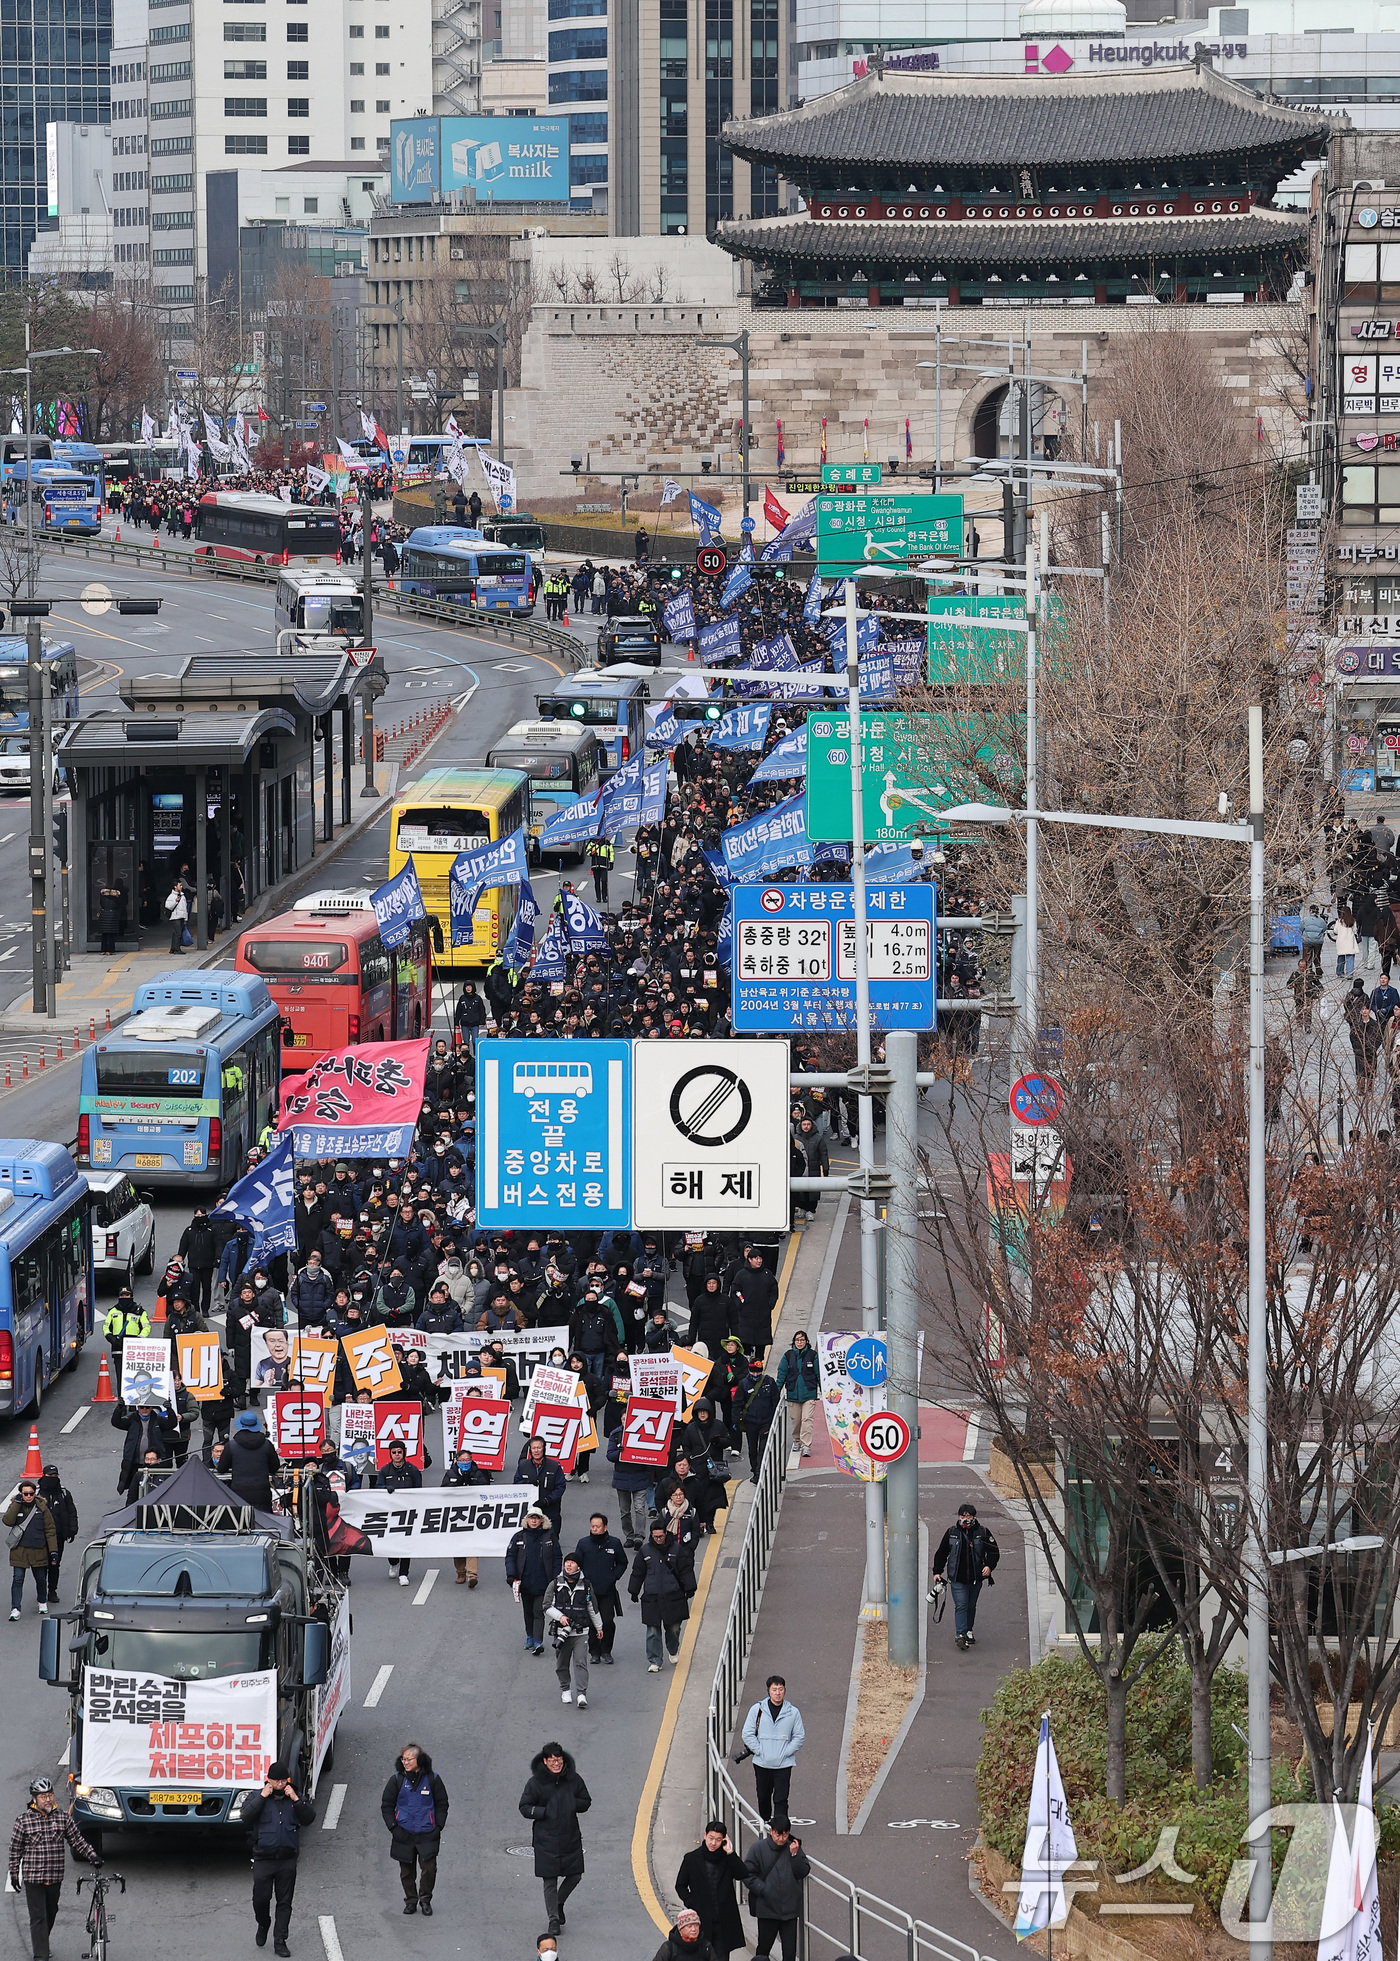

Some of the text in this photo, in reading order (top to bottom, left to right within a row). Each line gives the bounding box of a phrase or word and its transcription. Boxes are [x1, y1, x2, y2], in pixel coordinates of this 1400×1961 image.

[1090, 42, 1189, 66] Heungkuk
[508, 143, 560, 158] 복사지는
[509, 160, 553, 178] miilk
[1357, 321, 1391, 339] 사교
[1345, 399, 1373, 411] 지루박
[829, 468, 873, 480] 숭례문
[834, 500, 867, 512] 광화문
[907, 530, 949, 542] 한국은행
[907, 543, 960, 551] The Bank Of Korea
[703, 556, 719, 568] 50
[599, 707, 614, 718] 151
[815, 724, 830, 735] 50
[831, 752, 845, 763] 60
[869, 763, 885, 773] Hall
[875, 827, 908, 839] 180m
[453, 837, 488, 850] 4108
[869, 890, 907, 911] 제한
[743, 926, 791, 947] 총중량
[798, 929, 827, 946] 32t
[891, 924, 926, 938] 4.0m
[884, 943, 926, 956] 16.7m
[303, 955, 330, 968] 9401
[743, 955, 827, 975] 축하중 10t
[892, 961, 926, 975] 2.5m
[740, 1000, 779, 1011] 2004년
[783, 1000, 800, 1011] 3월
[172, 1069, 197, 1084] 202
[130, 1101, 161, 1110] Beauty
[527, 1098, 579, 1124] 전용
[541, 1124, 566, 1148] 끝
[503, 1149, 604, 1176] 중앙차로
[669, 1170, 752, 1200] 해제
[503, 1181, 604, 1208] 버스전용
[125, 1351, 166, 1362] 윤석열을
[352, 1336, 393, 1387] 주
[125, 1362, 166, 1372] 체포하라
[182, 1345, 220, 1388] 내
[536, 1367, 574, 1385] 금속노조
[639, 1375, 678, 1387] 윤석열을
[533, 1378, 572, 1396] 선봉에서
[639, 1386, 678, 1397] 체포하라
[280, 1402, 323, 1445] 윤
[345, 1419, 375, 1430] 윤석열
[625, 1408, 674, 1451] 진
[376, 1413, 421, 1457] 석
[460, 1408, 508, 1456] 열
[534, 1415, 581, 1460] 퇴
[870, 1425, 900, 1451] 50
[361, 1501, 529, 1538] 즉각 퇴진하라
[89, 1673, 187, 1700] 반란수괴
[88, 1699, 186, 1725] 윤석열을
[148, 1721, 262, 1750] 체포하고
[148, 1752, 271, 1781] 처벌하라!
[176, 1793, 199, 1803] 3290
